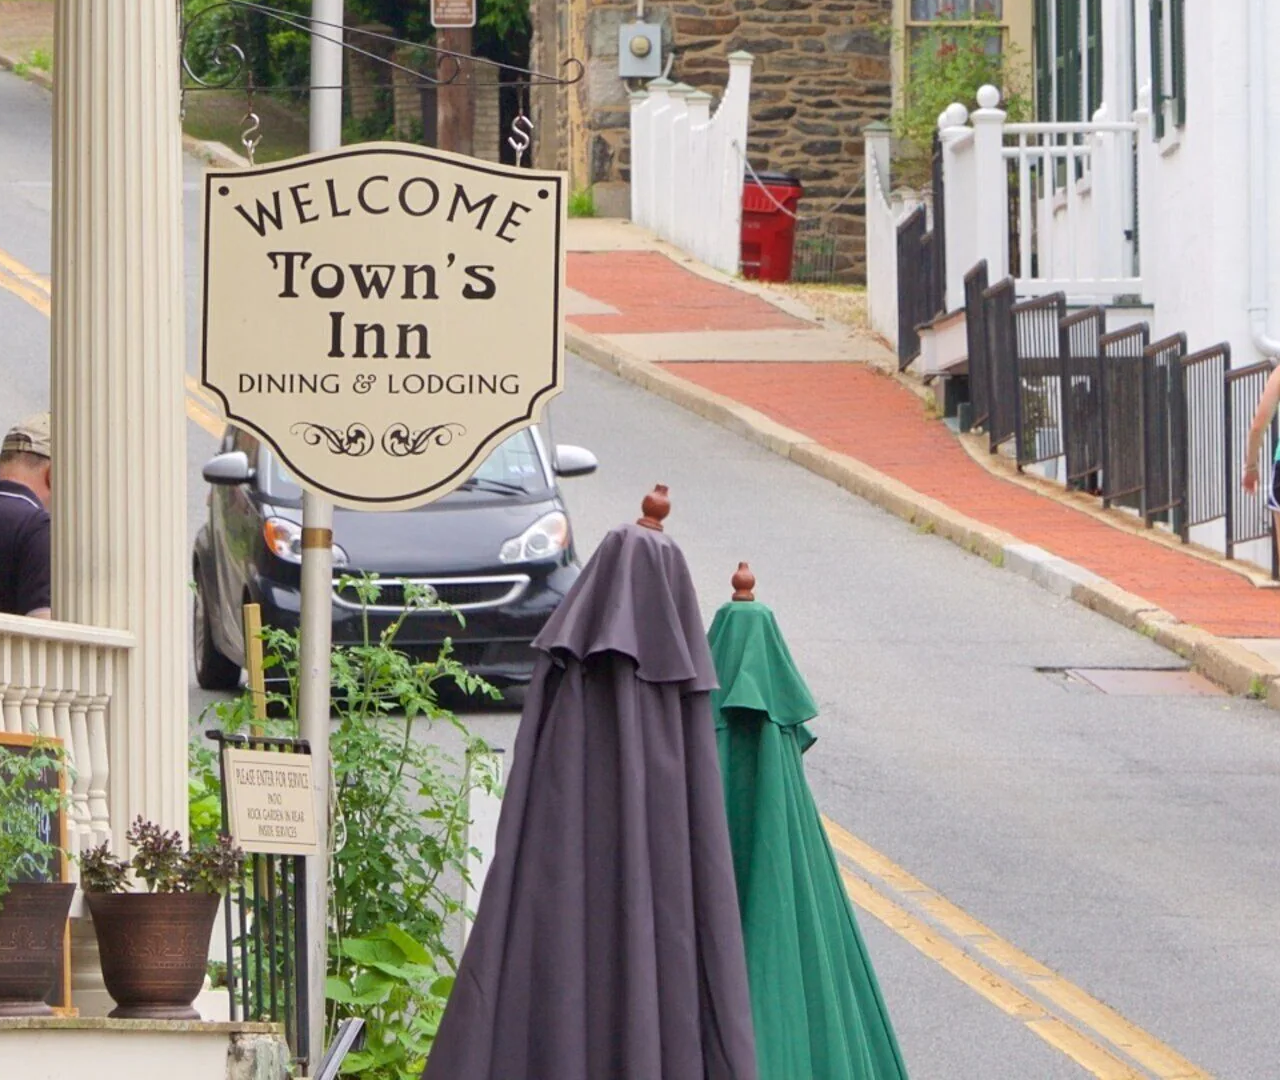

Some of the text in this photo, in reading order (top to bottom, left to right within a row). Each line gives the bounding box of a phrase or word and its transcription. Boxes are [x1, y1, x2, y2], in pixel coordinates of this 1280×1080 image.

[234, 176, 532, 243] WELCOME
[267, 251, 497, 300] Town's
[327, 311, 432, 359] Inn
[239, 374, 519, 394] DINING & LODGING
[236, 767, 256, 786] PLEASE
